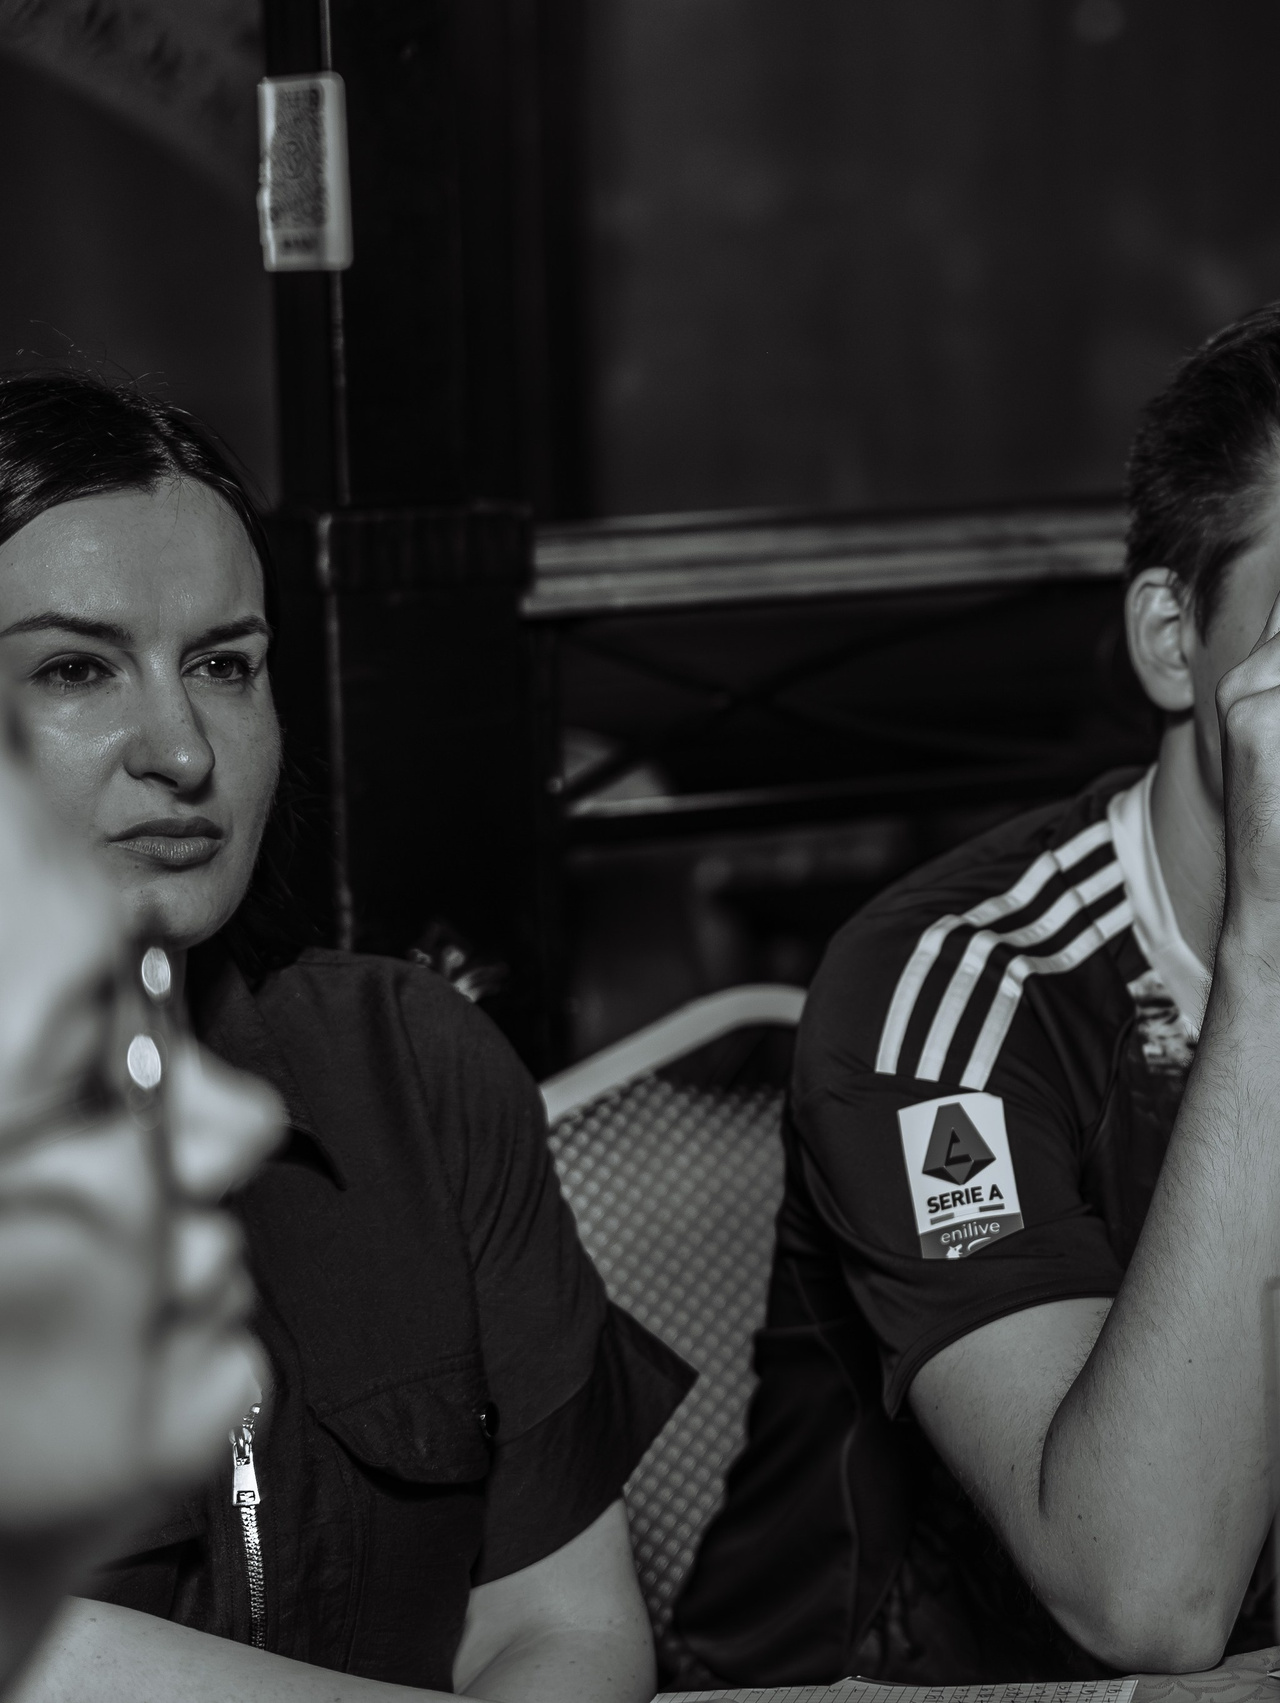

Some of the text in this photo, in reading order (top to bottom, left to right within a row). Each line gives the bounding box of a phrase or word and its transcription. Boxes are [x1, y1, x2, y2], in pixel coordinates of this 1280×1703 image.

[927, 1185, 1003, 1213] SERIE A
[940, 1221, 1000, 1243] enilive
